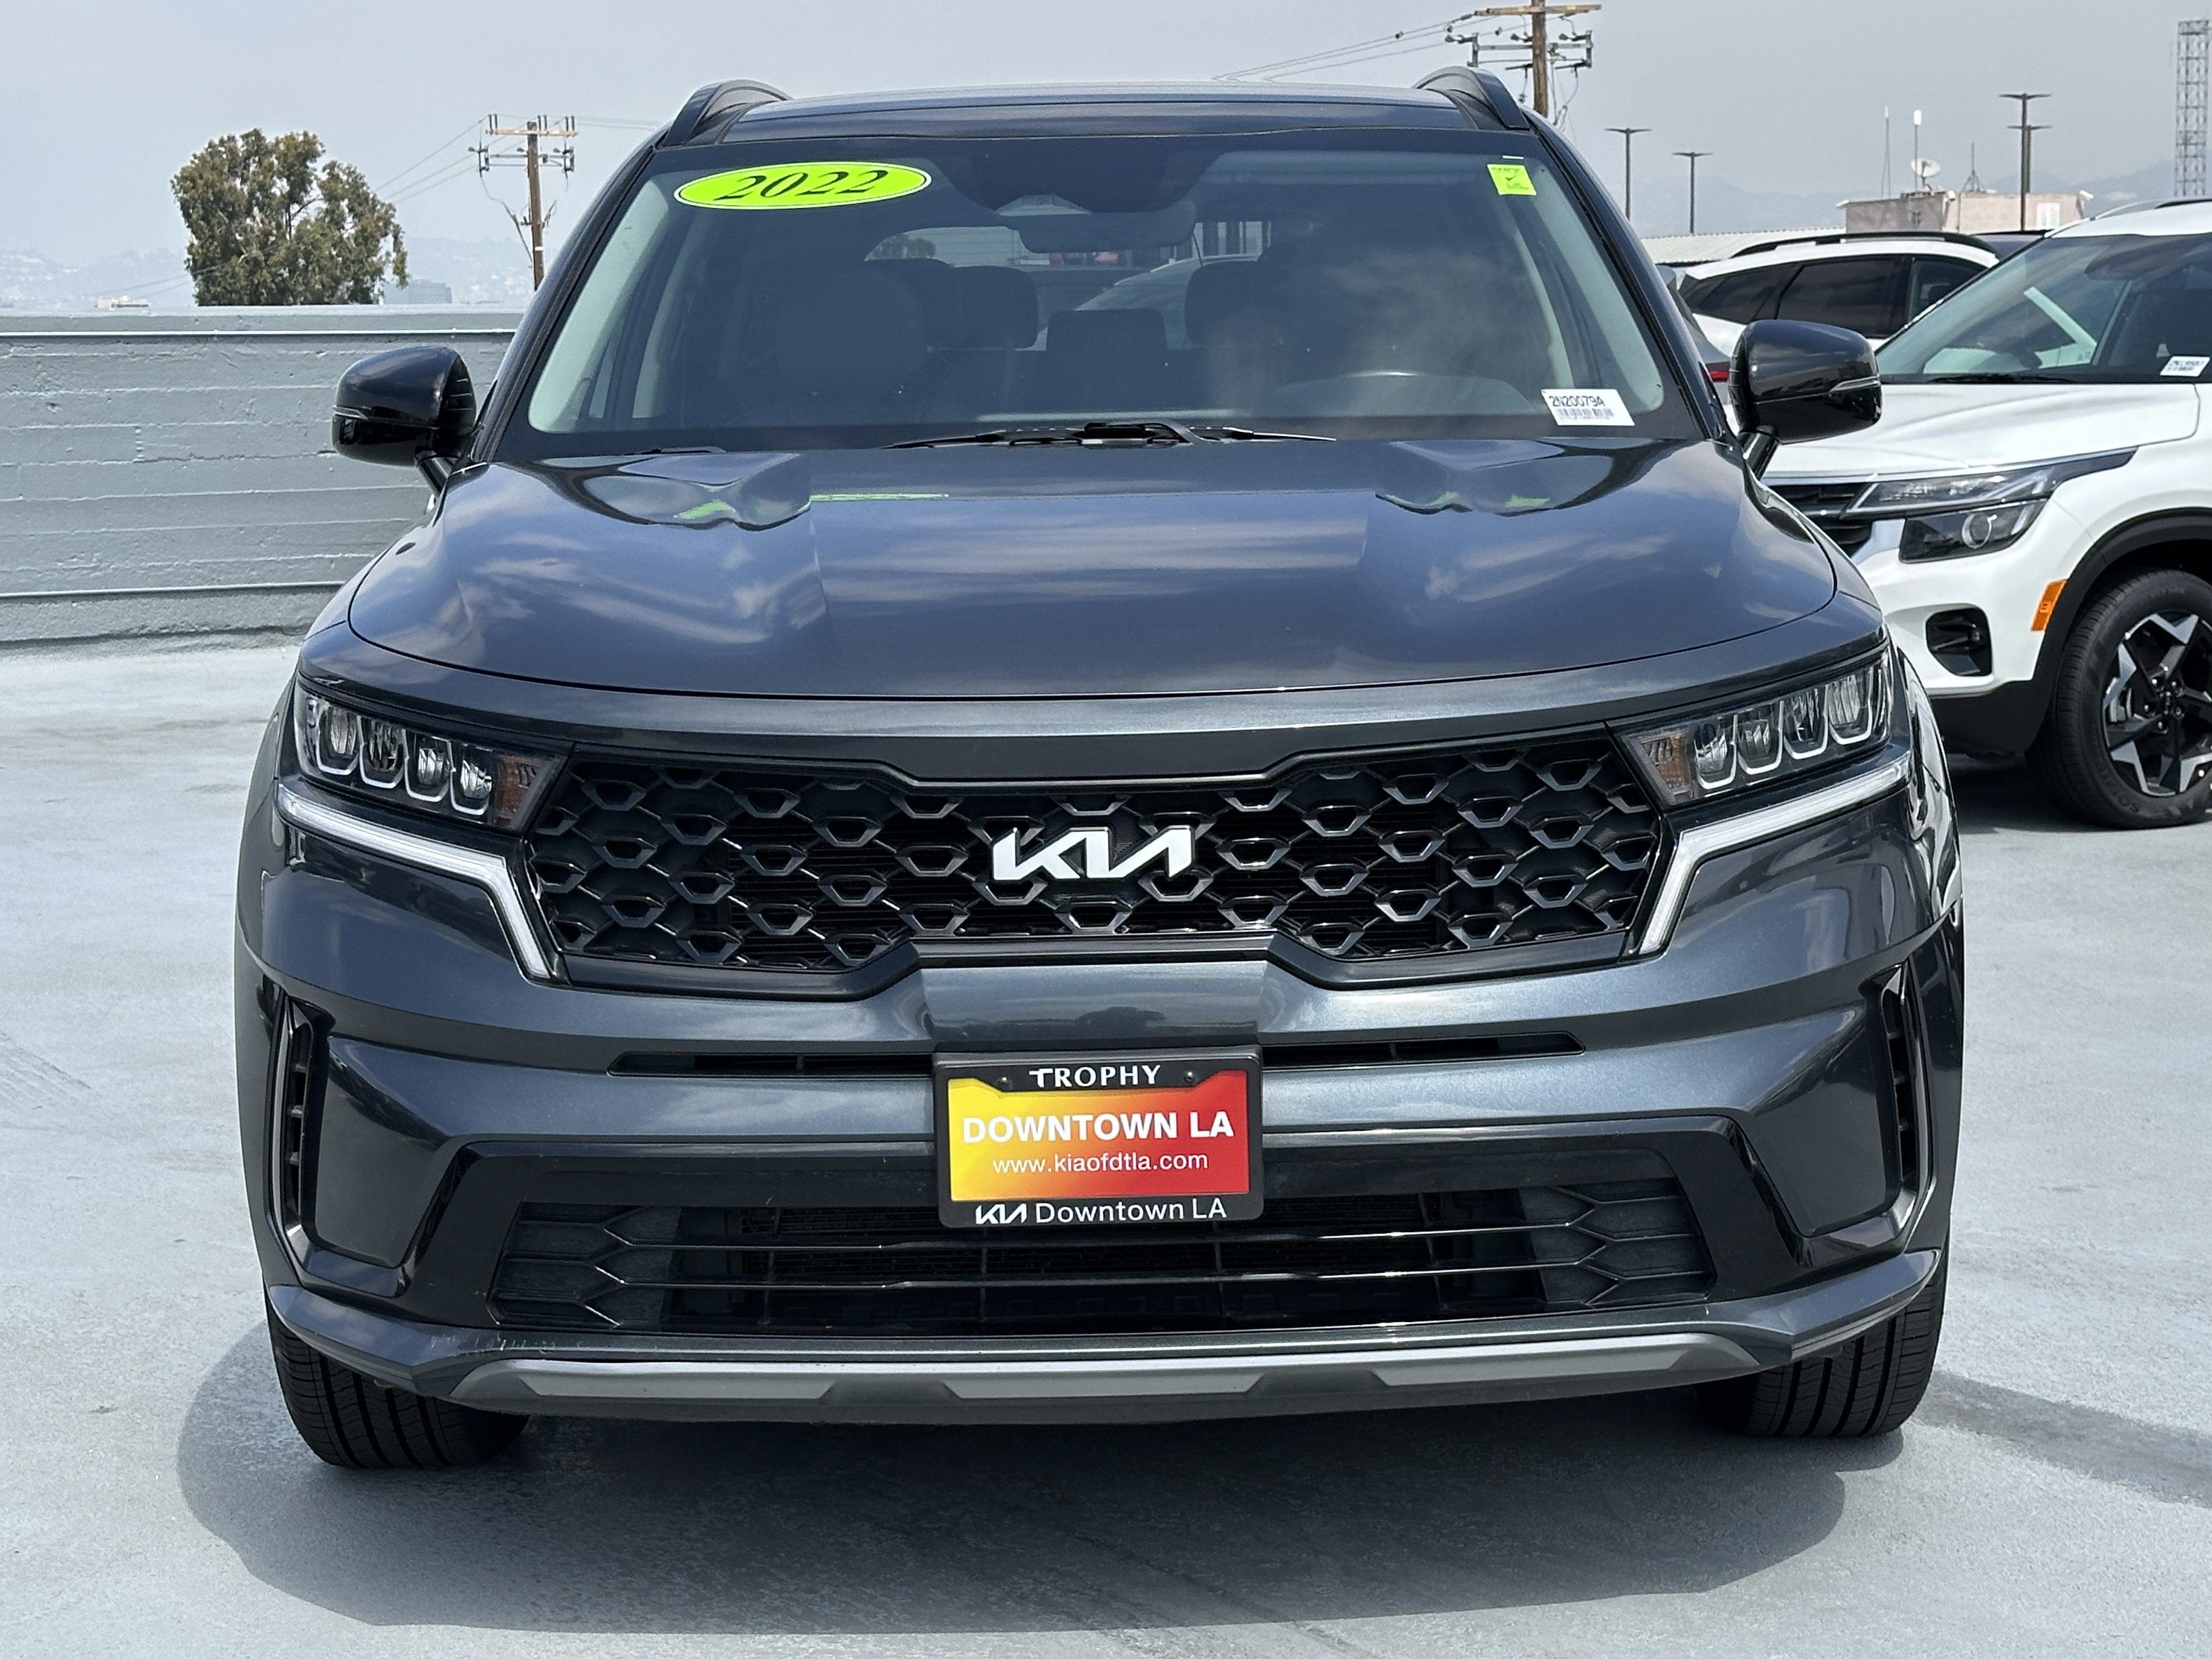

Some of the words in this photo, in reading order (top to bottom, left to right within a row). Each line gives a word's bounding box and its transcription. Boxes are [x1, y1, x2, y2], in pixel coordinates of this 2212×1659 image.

[713, 170, 888, 201] 2022
[993, 825, 1192, 881] KIA
[1029, 1065, 1161, 1088] TROPHY
[963, 1111, 1177, 1143] DOWNTOWN
[1189, 1111, 1234, 1138] LA
[992, 1153, 1209, 1173] www.kiaofdtla.com
[975, 1203, 1027, 1224] KIA
[1036, 1201, 1184, 1223] Downtown
[1192, 1198, 1227, 1219] LA
